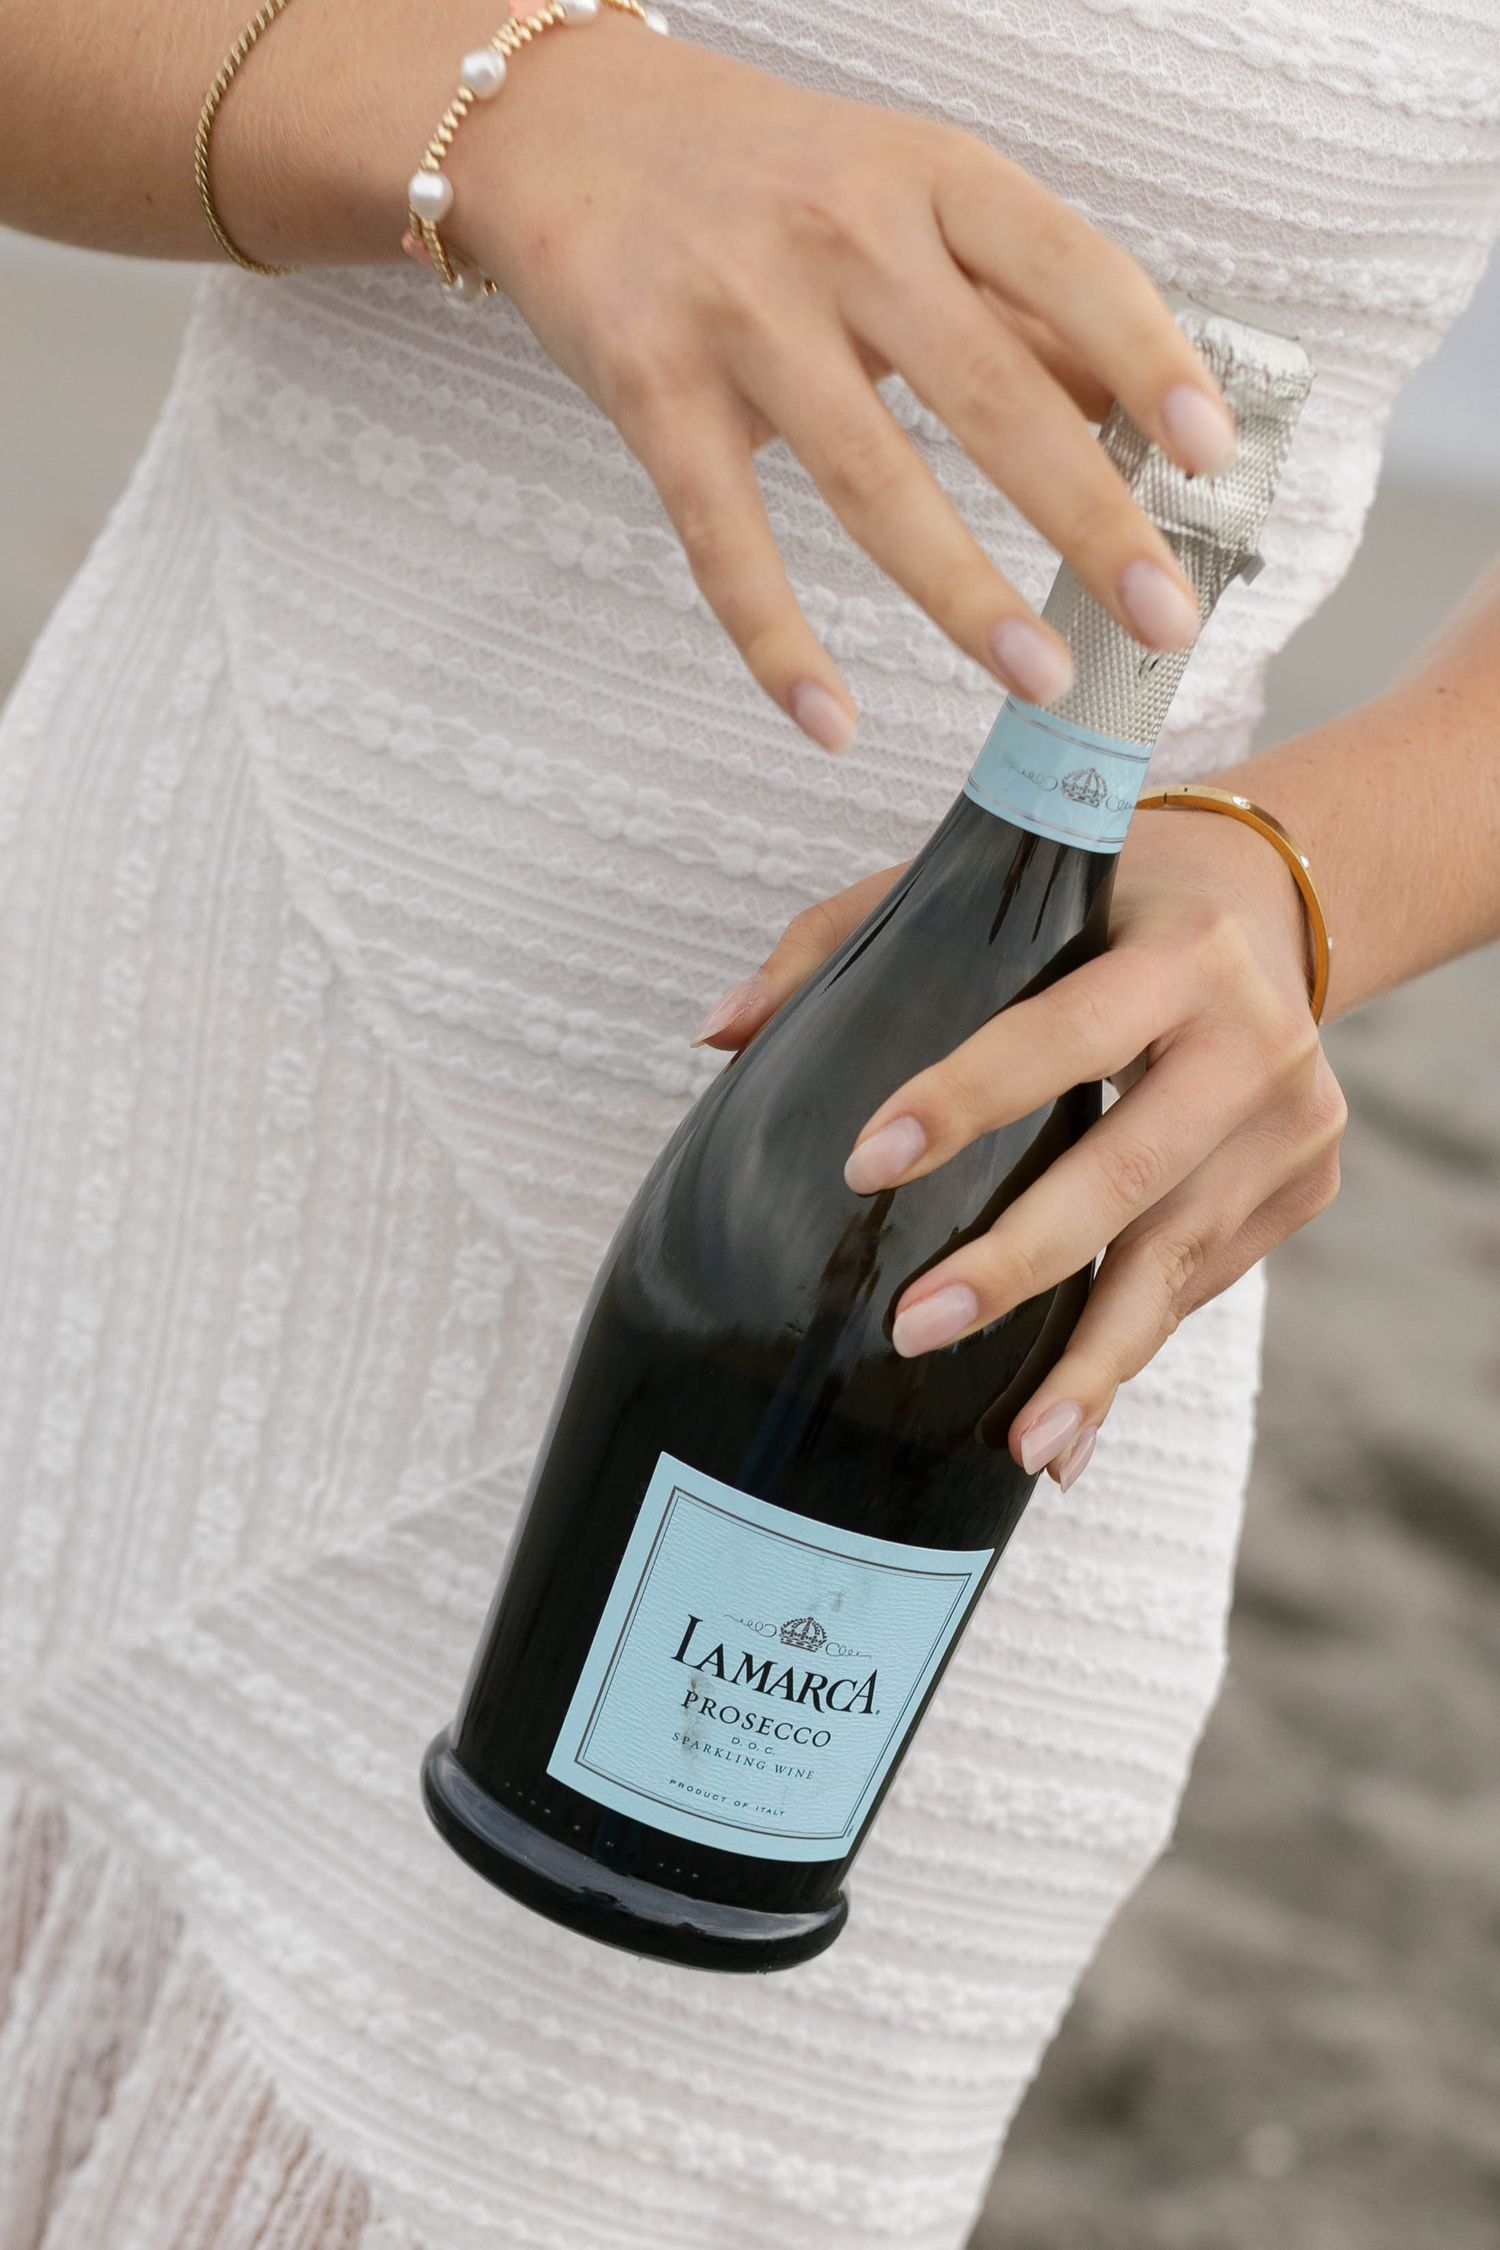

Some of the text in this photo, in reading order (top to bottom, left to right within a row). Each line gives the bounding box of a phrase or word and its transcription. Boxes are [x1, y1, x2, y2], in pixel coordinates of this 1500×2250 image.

[670, 1613, 879, 1714] LAMARCA
[681, 1689, 832, 1748] PROSECCO
[672, 1731, 816, 1780] SPARKLING WINE
[669, 1779, 785, 1816] PRODUCT OF ITALY
